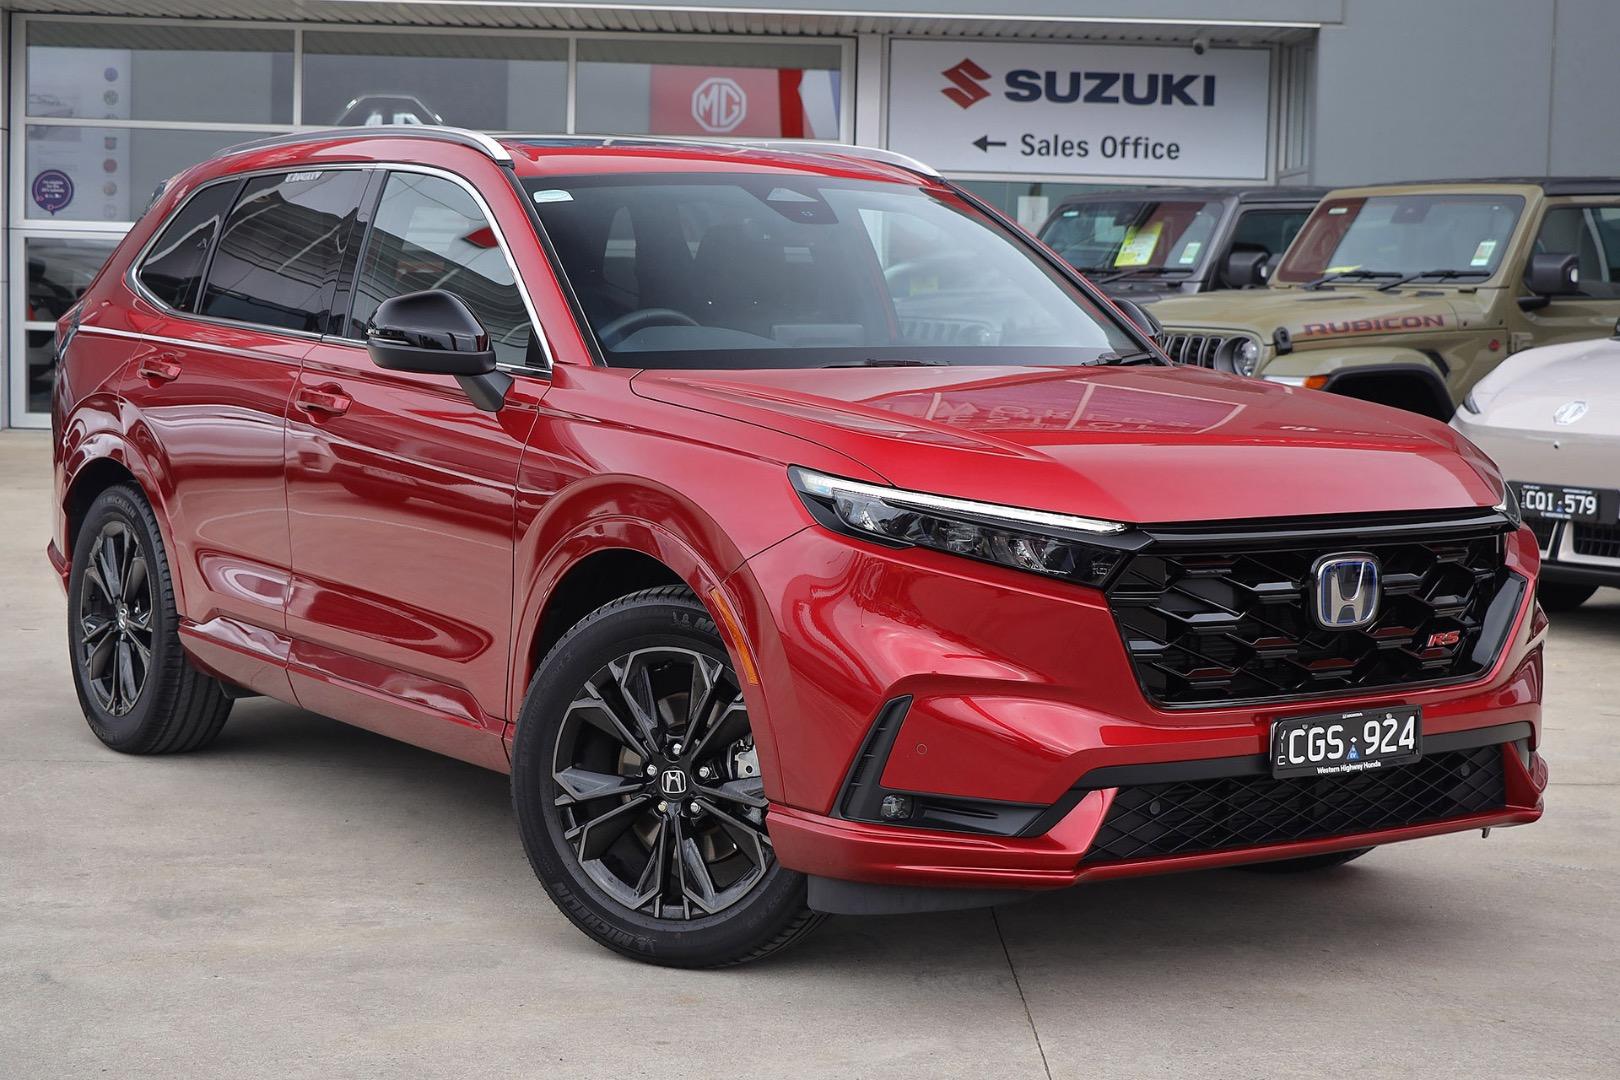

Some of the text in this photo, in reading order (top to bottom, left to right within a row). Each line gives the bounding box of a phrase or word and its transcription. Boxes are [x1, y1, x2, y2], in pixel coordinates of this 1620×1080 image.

[1004, 69, 1216, 107] SUZUKI
[698, 83, 741, 128] MG
[1020, 134, 1180, 160] Sales Office
[1303, 313, 1445, 336] RUBICON
[1564, 494, 1597, 515] 579
[1288, 716, 1415, 764] CGS 924
[1316, 760, 1382, 775] Western Highway Honda
